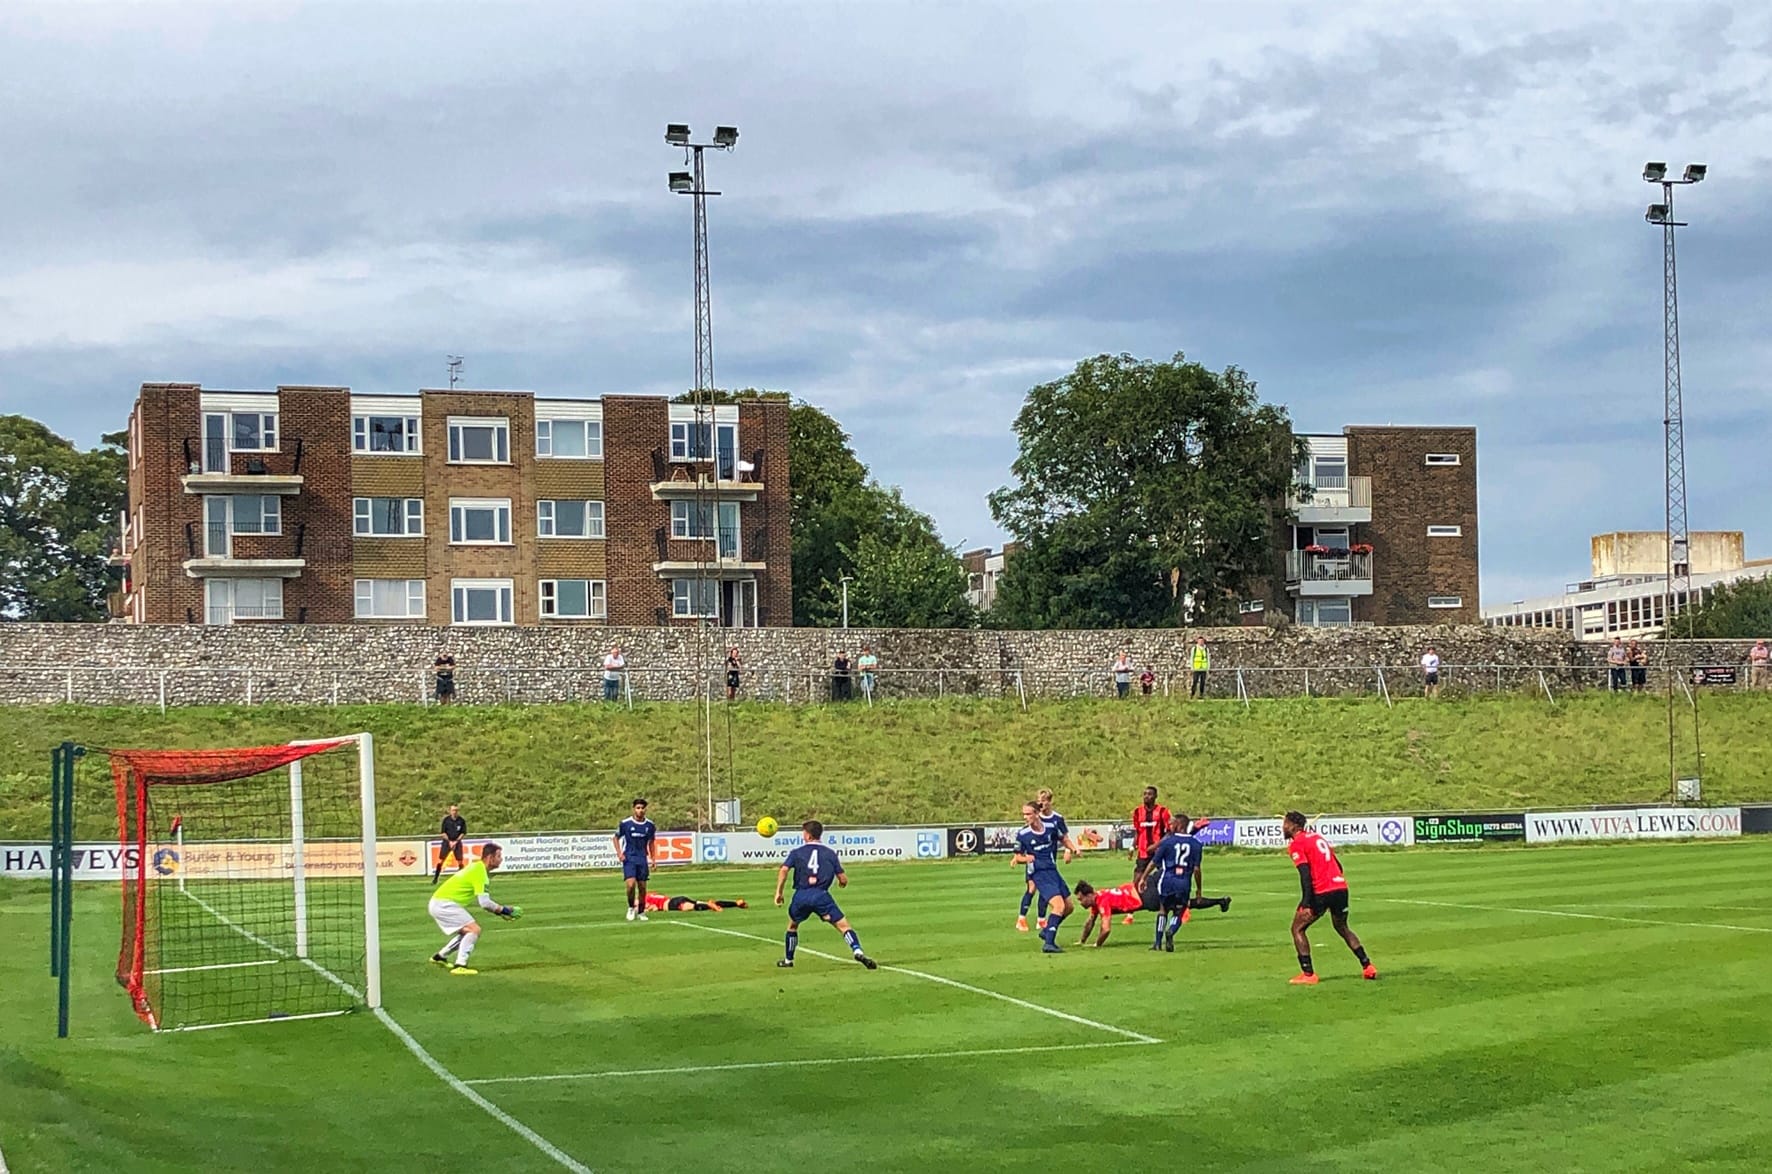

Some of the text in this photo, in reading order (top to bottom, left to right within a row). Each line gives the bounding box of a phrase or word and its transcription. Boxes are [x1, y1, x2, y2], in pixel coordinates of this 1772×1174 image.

[1200, 824, 1231, 840] depot
[1320, 823, 1369, 835] CINEMA
[1415, 819, 1483, 838] SignShop
[828, 835, 837, 844] &
[842, 835, 876, 845] loans
[1239, 838, 1260, 846] CAFE
[520, 845, 569, 853] Rainscreen
[1174, 843, 1191, 866] 12
[1316, 838, 1331, 861] 9
[5, 848, 141, 870] HAVEYS
[184, 851, 221, 862] Butler
[226, 851, 235, 862] &
[240, 850, 275, 864] Young
[505, 852, 619, 862] Membrane Roofing system
[807, 848, 820, 874] 4
